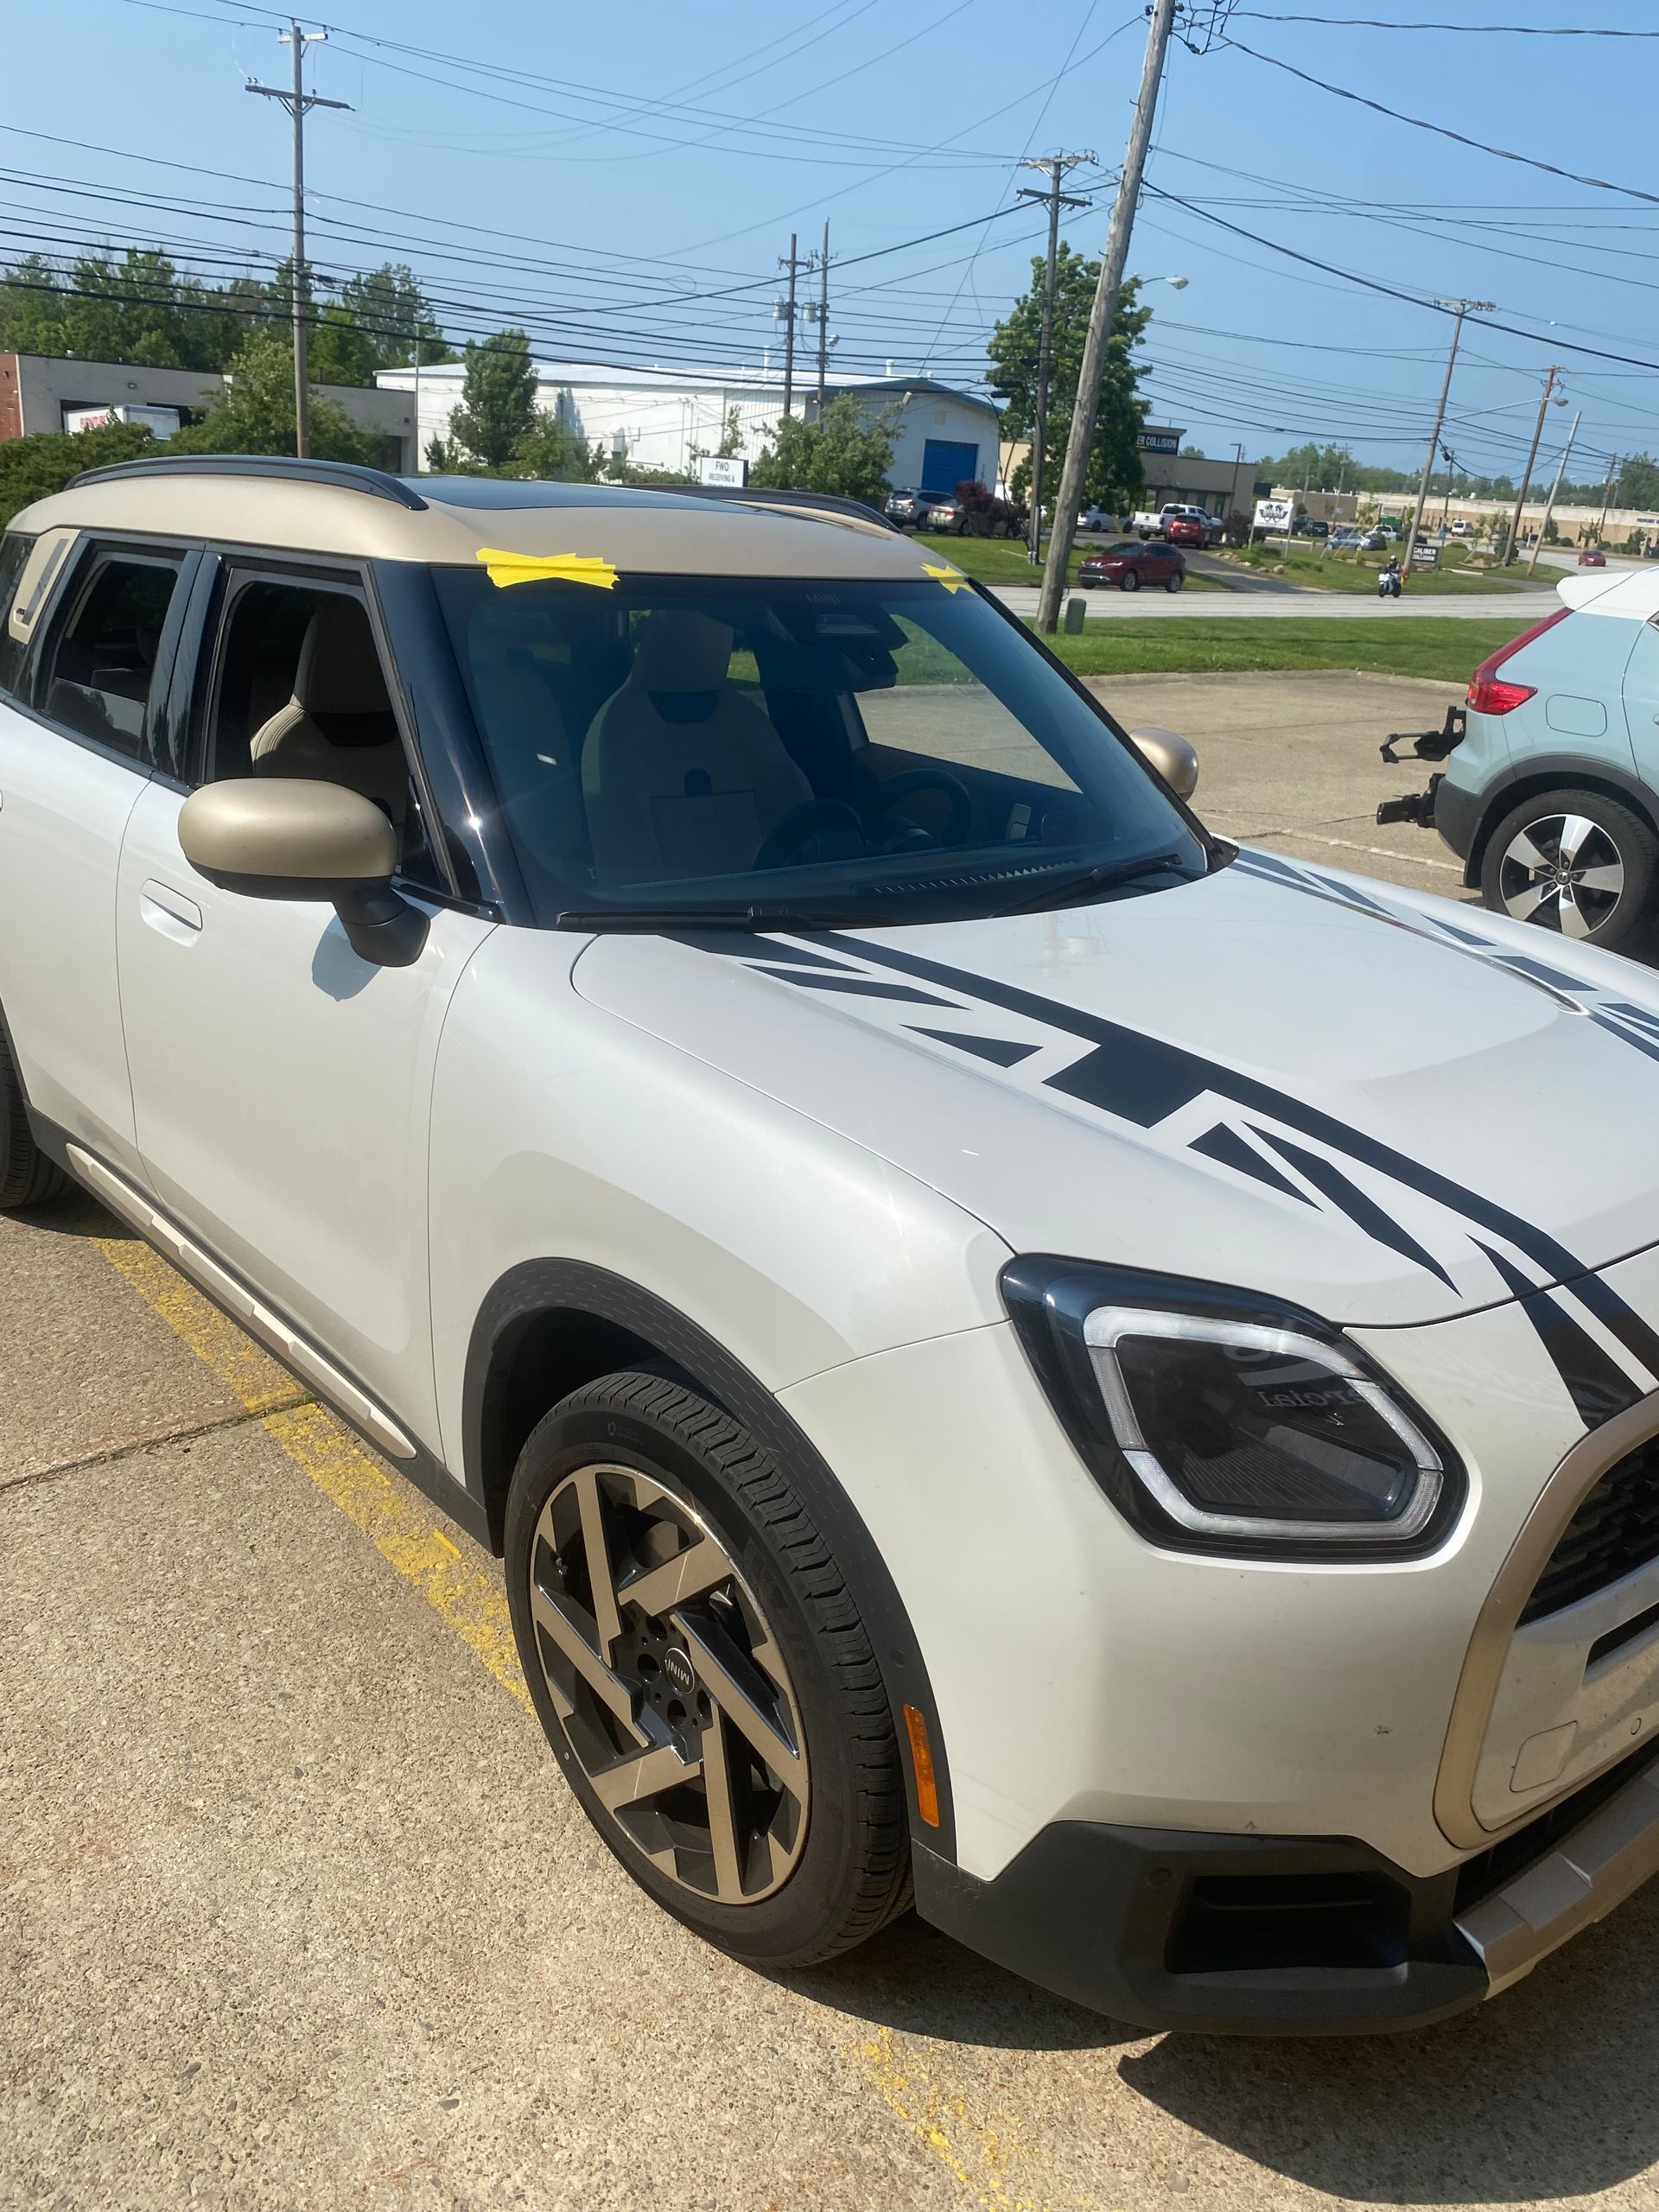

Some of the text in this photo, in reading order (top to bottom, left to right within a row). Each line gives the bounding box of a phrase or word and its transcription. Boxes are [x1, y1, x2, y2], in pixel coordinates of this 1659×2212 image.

[1146, 435, 1177, 449] COLLISION
[709, 473, 731, 483] RECEIVING
[1413, 546, 1436, 556] CALIBER
[804, 594, 842, 604] MINI
[668, 1659, 690, 1686] MINI
